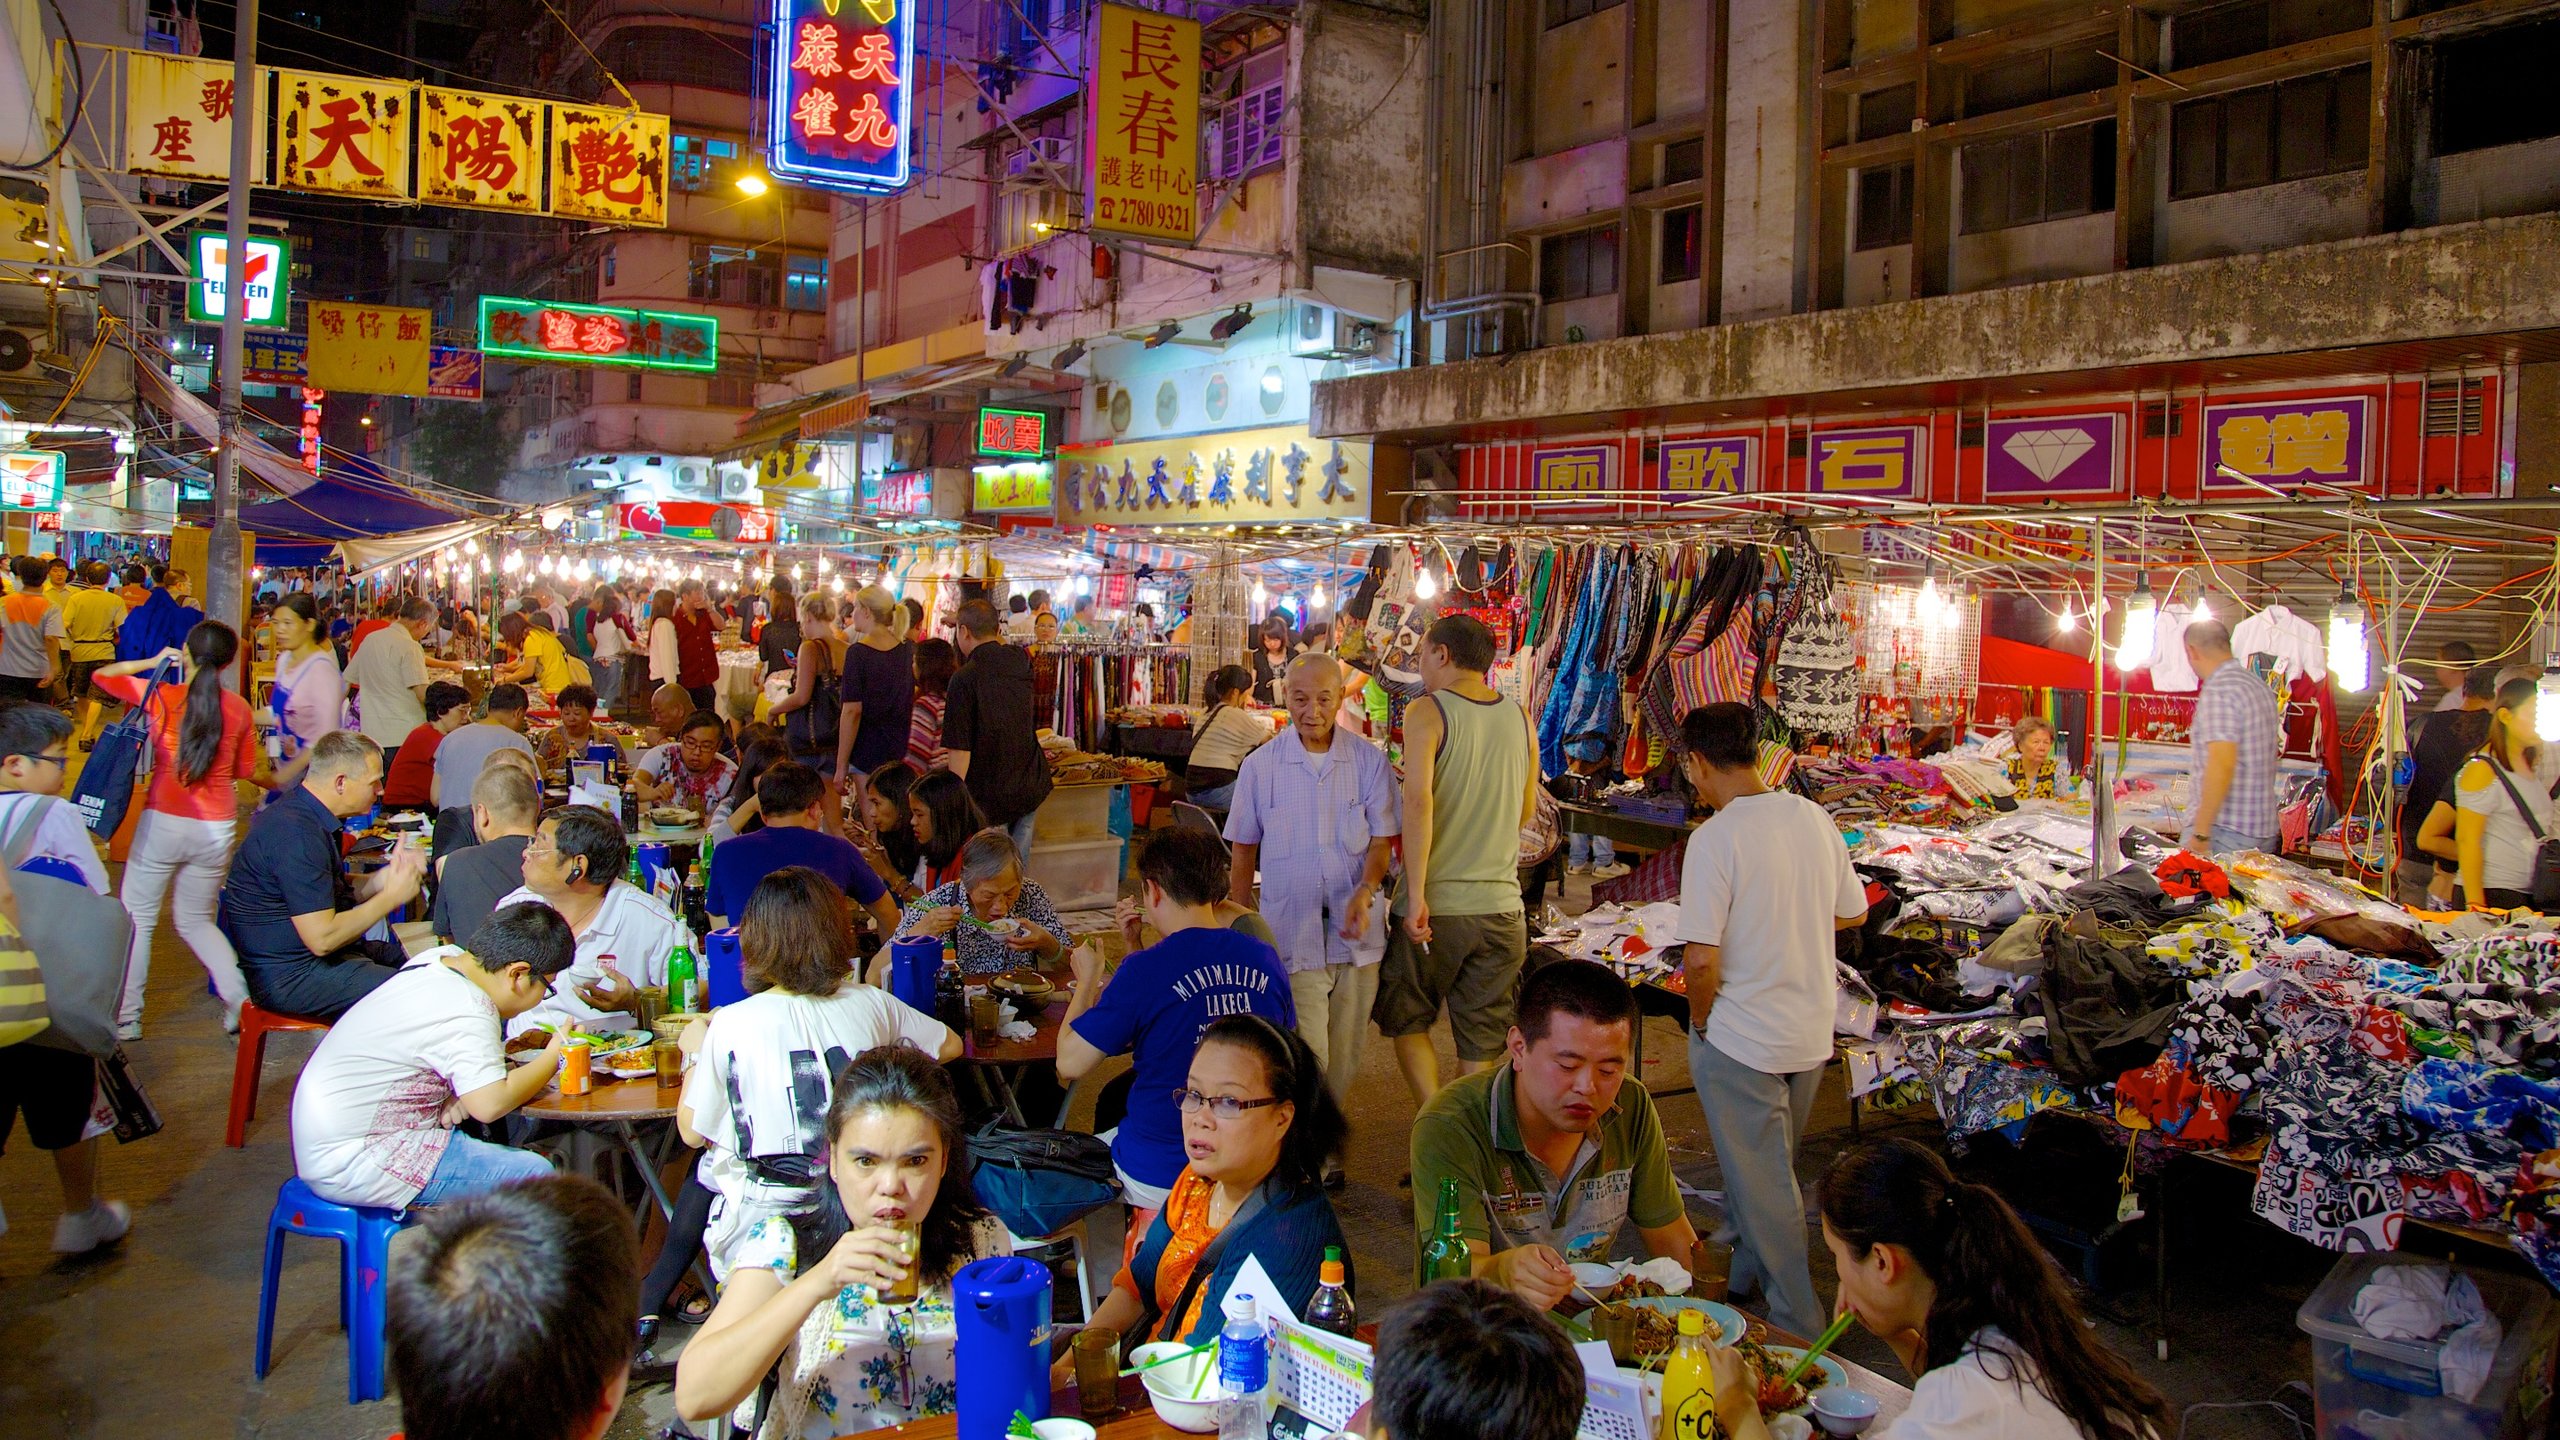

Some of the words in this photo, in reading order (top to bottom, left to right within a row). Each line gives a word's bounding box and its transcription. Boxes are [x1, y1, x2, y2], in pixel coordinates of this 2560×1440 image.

[1117, 19, 1181, 159] 長春
[1101, 155, 1193, 196] 護老中心
[1119, 197, 1155, 229] 2780
[1157, 202, 1190, 232] 9321
[1172, 963, 1270, 1002] MINIMALISM
